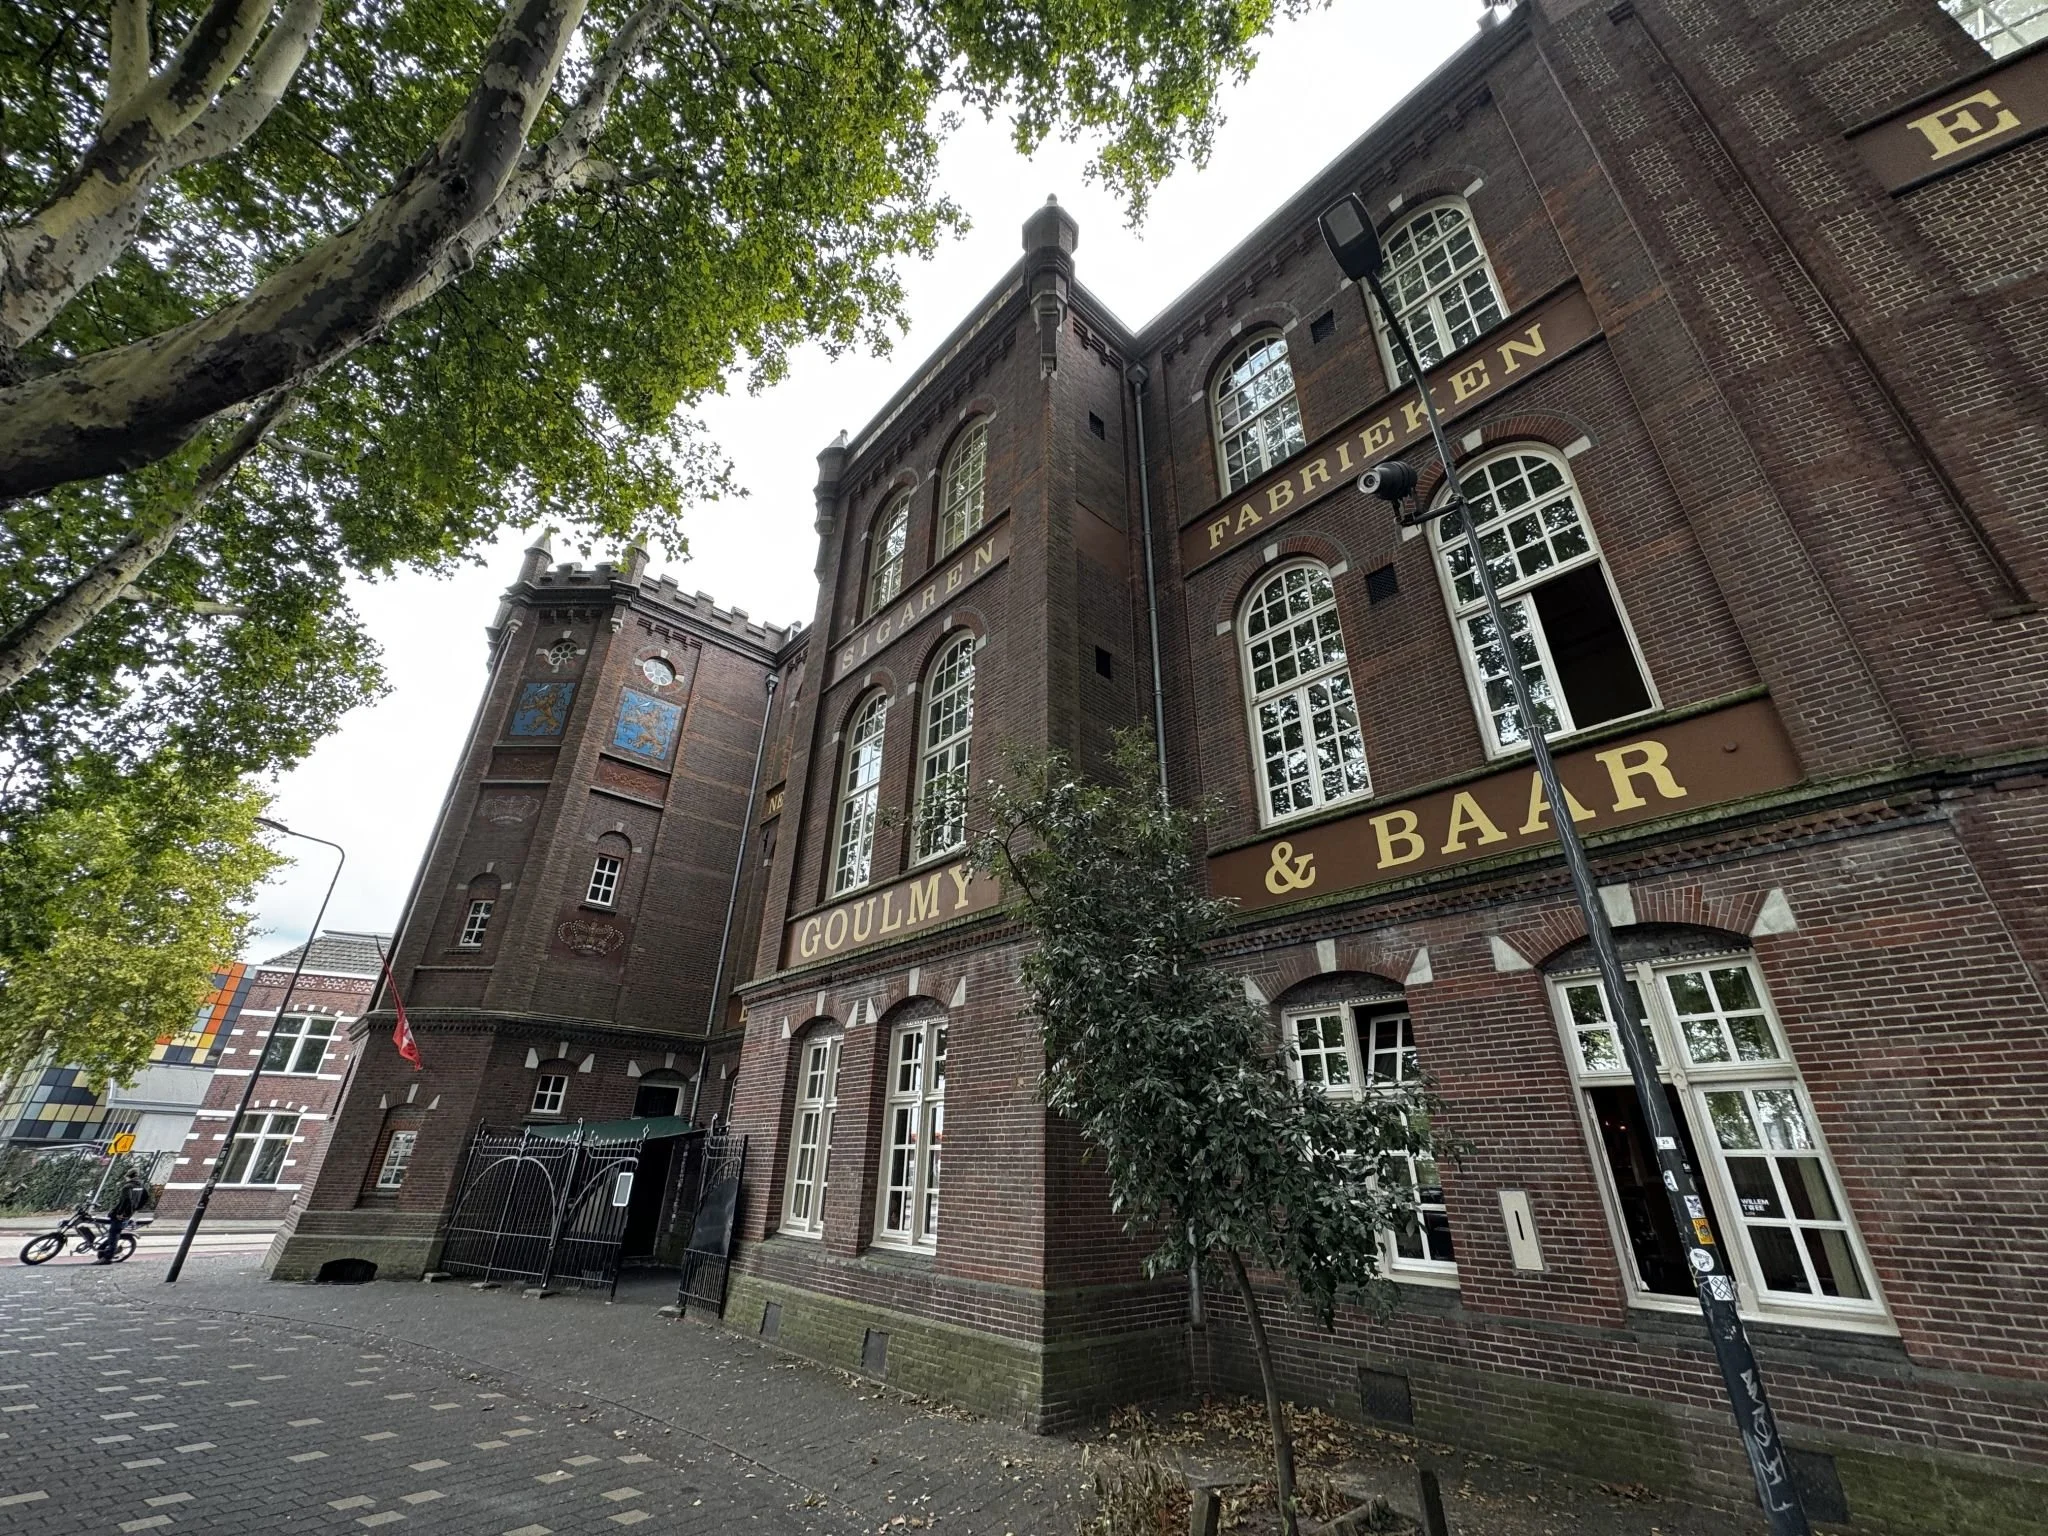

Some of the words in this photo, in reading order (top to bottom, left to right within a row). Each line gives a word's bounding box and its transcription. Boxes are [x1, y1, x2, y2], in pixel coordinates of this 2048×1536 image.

[1906, 89, 2022, 161] E
[1207, 322, 1547, 551] FABRIEKEN
[841, 537, 996, 671] SIGAREN
[1264, 841, 1316, 895] &
[1368, 740, 1688, 870] BAAR
[800, 861, 974, 958] GOULMY
[1740, 1197, 1770, 1206] WILLEM
[1742, 1204, 1766, 1212] TWEE
